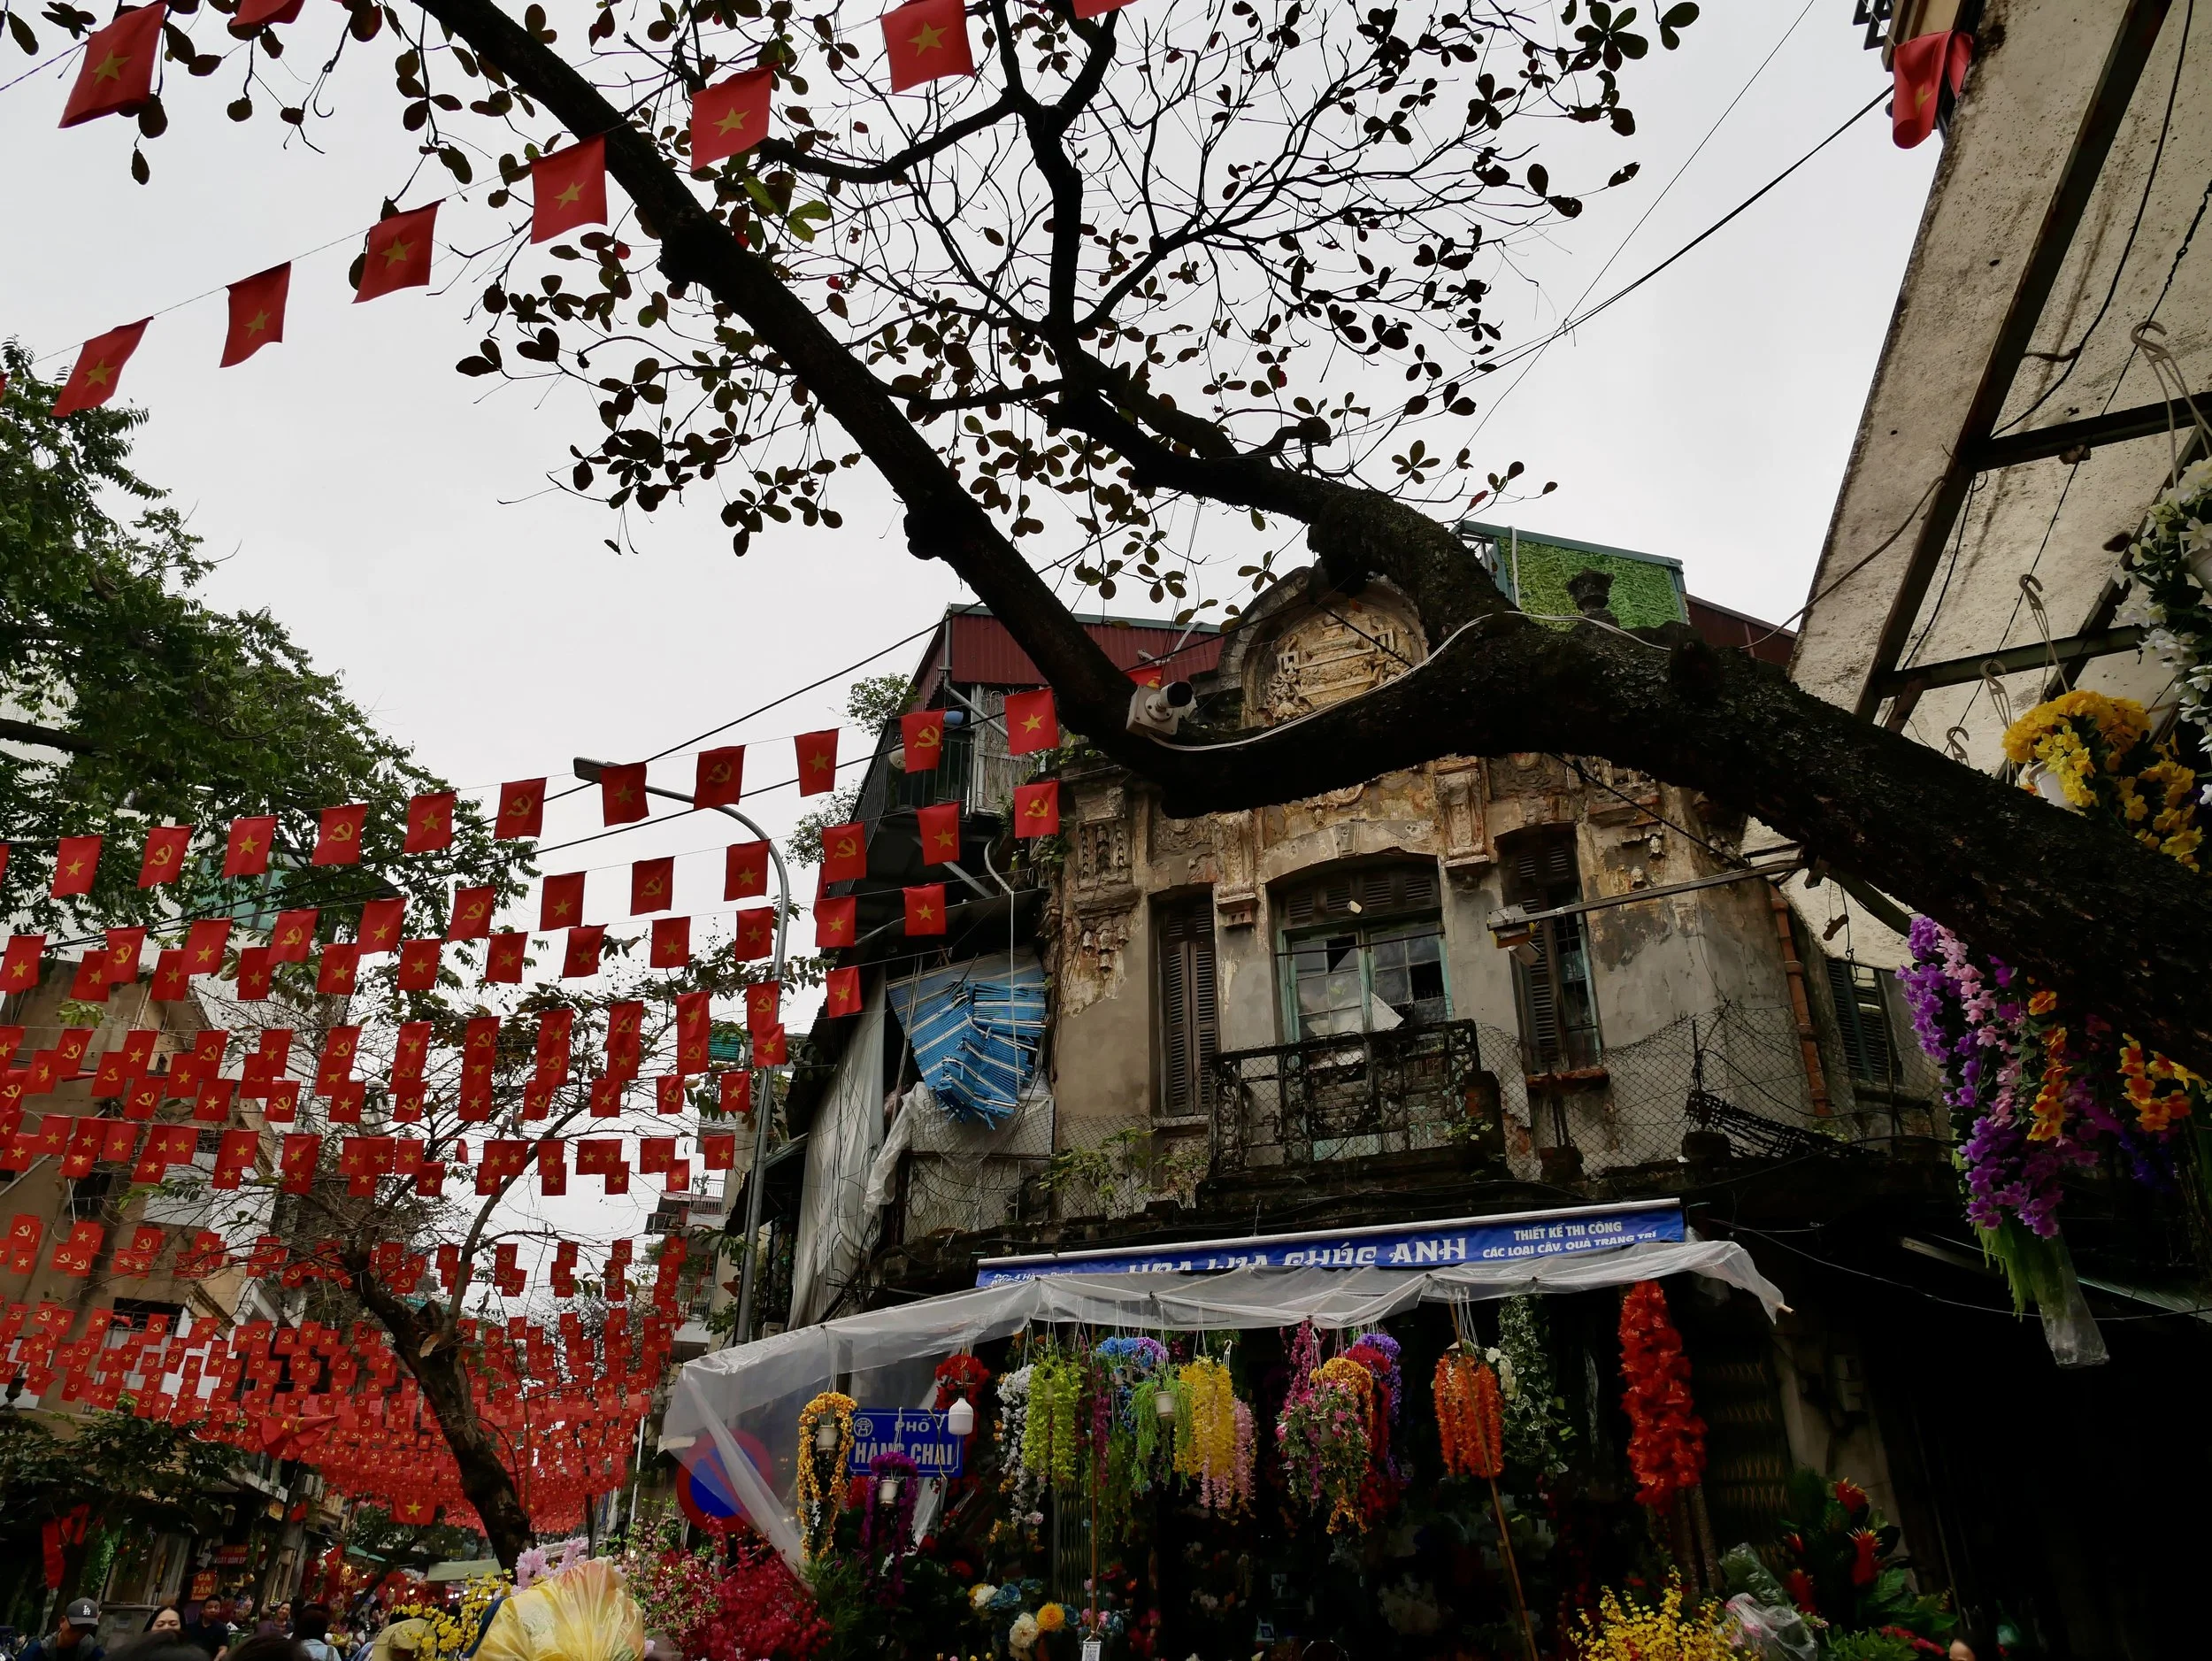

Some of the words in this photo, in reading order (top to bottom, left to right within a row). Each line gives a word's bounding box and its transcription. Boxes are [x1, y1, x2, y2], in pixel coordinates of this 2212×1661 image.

[1514, 1225, 1546, 1242] THIẾT
[1548, 1223, 1565, 1238] KẾ
[1566, 1225, 1586, 1237] THI
[1588, 1220, 1623, 1235] CÔNG
[1388, 1237, 1466, 1264] ANH
[1482, 1244, 1505, 1258] CÁC
[1508, 1243, 1534, 1257] LOẠI
[1565, 1238, 1592, 1250] QUÀ
[1595, 1234, 1635, 1247] TRANG
[895, 1416, 932, 1433] PHỐ
[910, 1443, 952, 1465] CHAI
